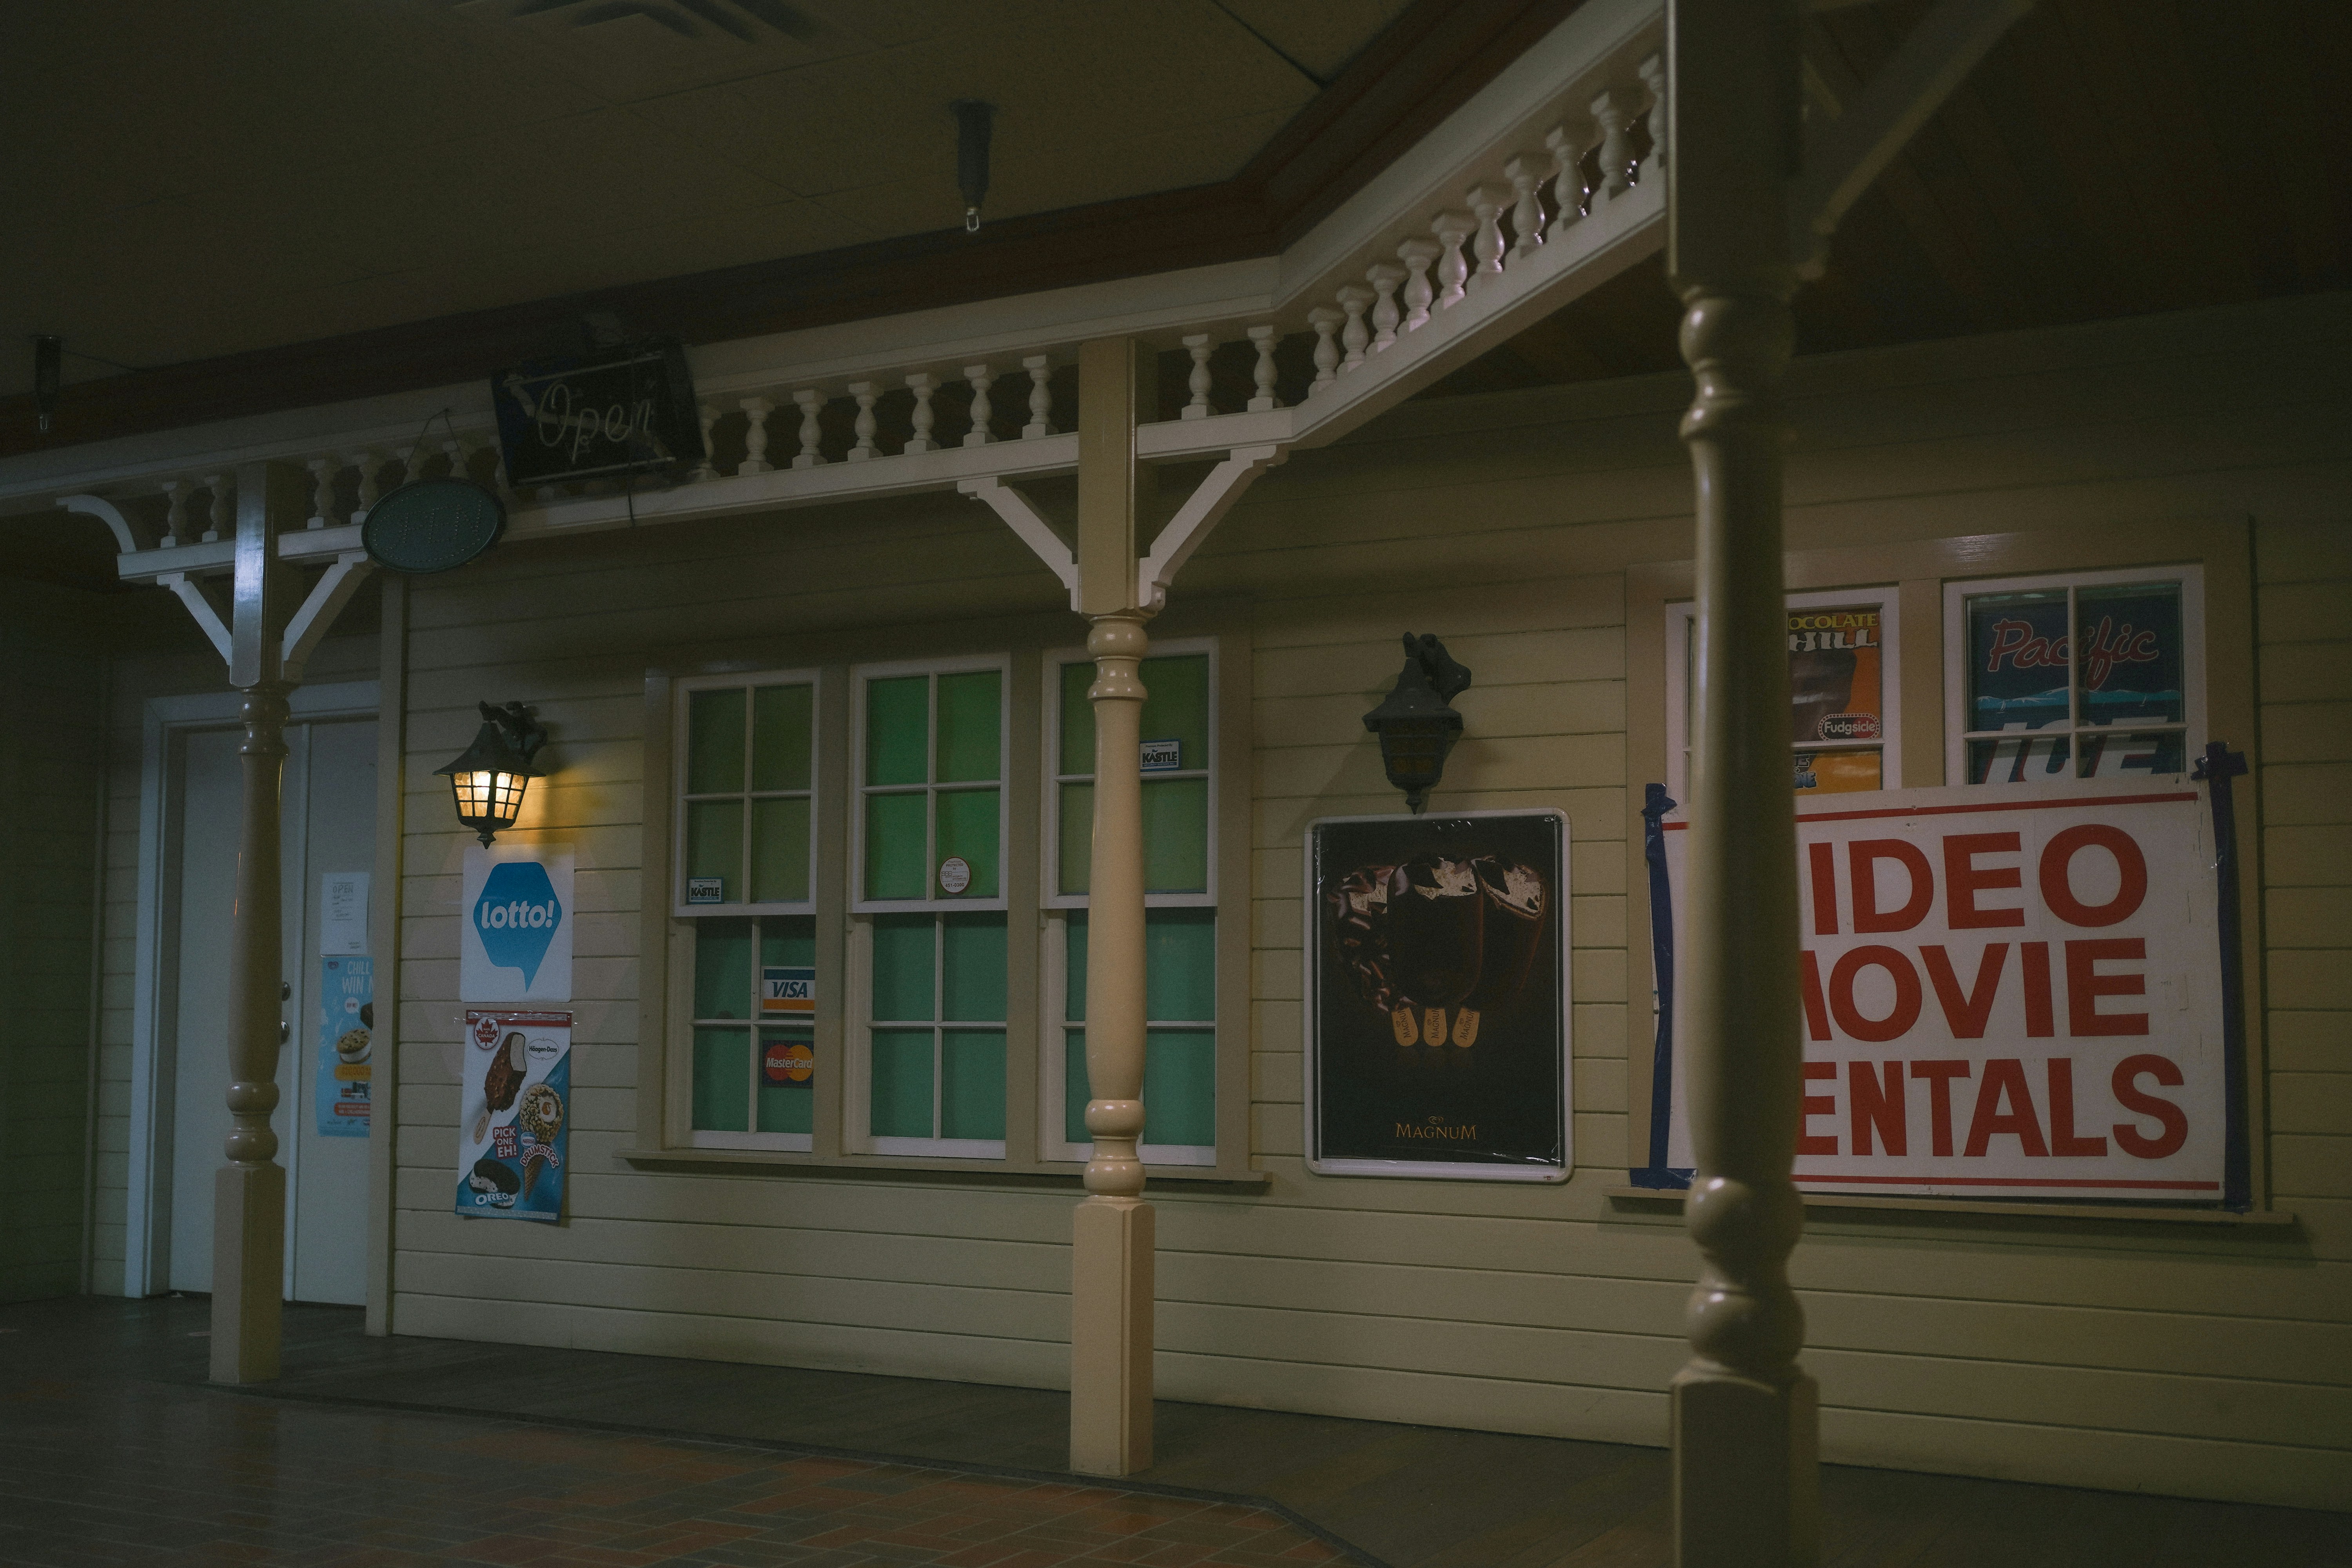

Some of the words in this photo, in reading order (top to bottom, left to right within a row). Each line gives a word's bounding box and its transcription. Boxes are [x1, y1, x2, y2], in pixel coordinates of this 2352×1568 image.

[536, 380, 652, 464] Open
[1788, 613, 1878, 630] OCOLATE
[1789, 628, 1878, 652] HILL
[1987, 615, 2159, 690] Pacific
[1824, 720, 1876, 735] Fudgsicle
[1142, 751, 1177, 763] KASTLE
[1809, 823, 2148, 935] IDEO
[333, 884, 353, 893] OPEN
[691, 887, 720, 897] KASTLE
[481, 900, 554, 929] lotto!
[347, 960, 370, 975] CHILL
[341, 976, 364, 994] WIN
[772, 981, 808, 998] VISA
[766, 1057, 813, 1069] MasterCard
[1800, 1054, 2188, 1159] ENTALS
[494, 1127, 516, 1138] PICK
[1396, 1122, 1477, 1140] MAGNUM
[497, 1145, 517, 1157] EH!
[475, 1192, 509, 1205] OREO
